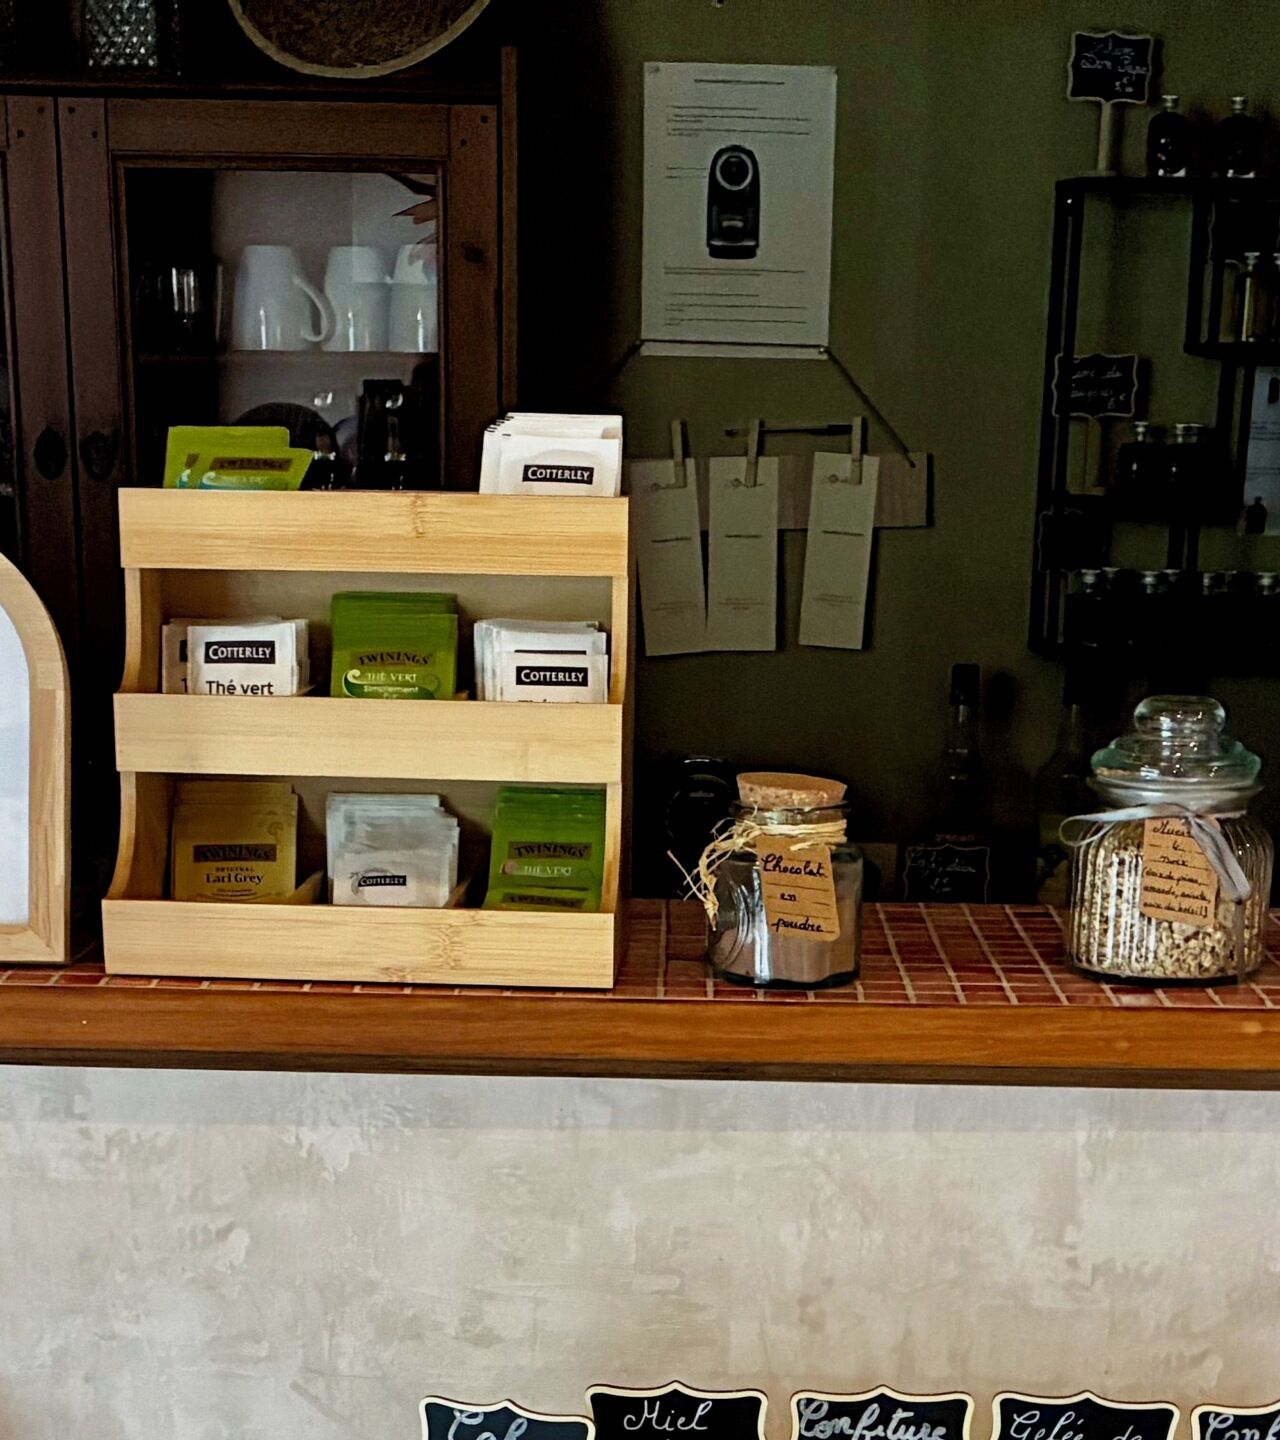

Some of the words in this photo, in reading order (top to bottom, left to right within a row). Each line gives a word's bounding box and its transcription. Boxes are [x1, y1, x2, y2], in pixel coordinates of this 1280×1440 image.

[527, 466, 590, 480] COTTERLEY
[208, 645, 272, 660] COTTERLEY
[359, 651, 433, 665] TWININGS
[520, 669, 585, 682] COTTERLEY
[206, 678, 236, 695] Thé
[241, 680, 274, 695] vert
[761, 853, 828, 879] Chocolat
[234, 873, 264, 885] Grey
[780, 892, 797, 902] en
[771, 916, 825, 932] poudre
[623, 1399, 713, 1431] Miel
